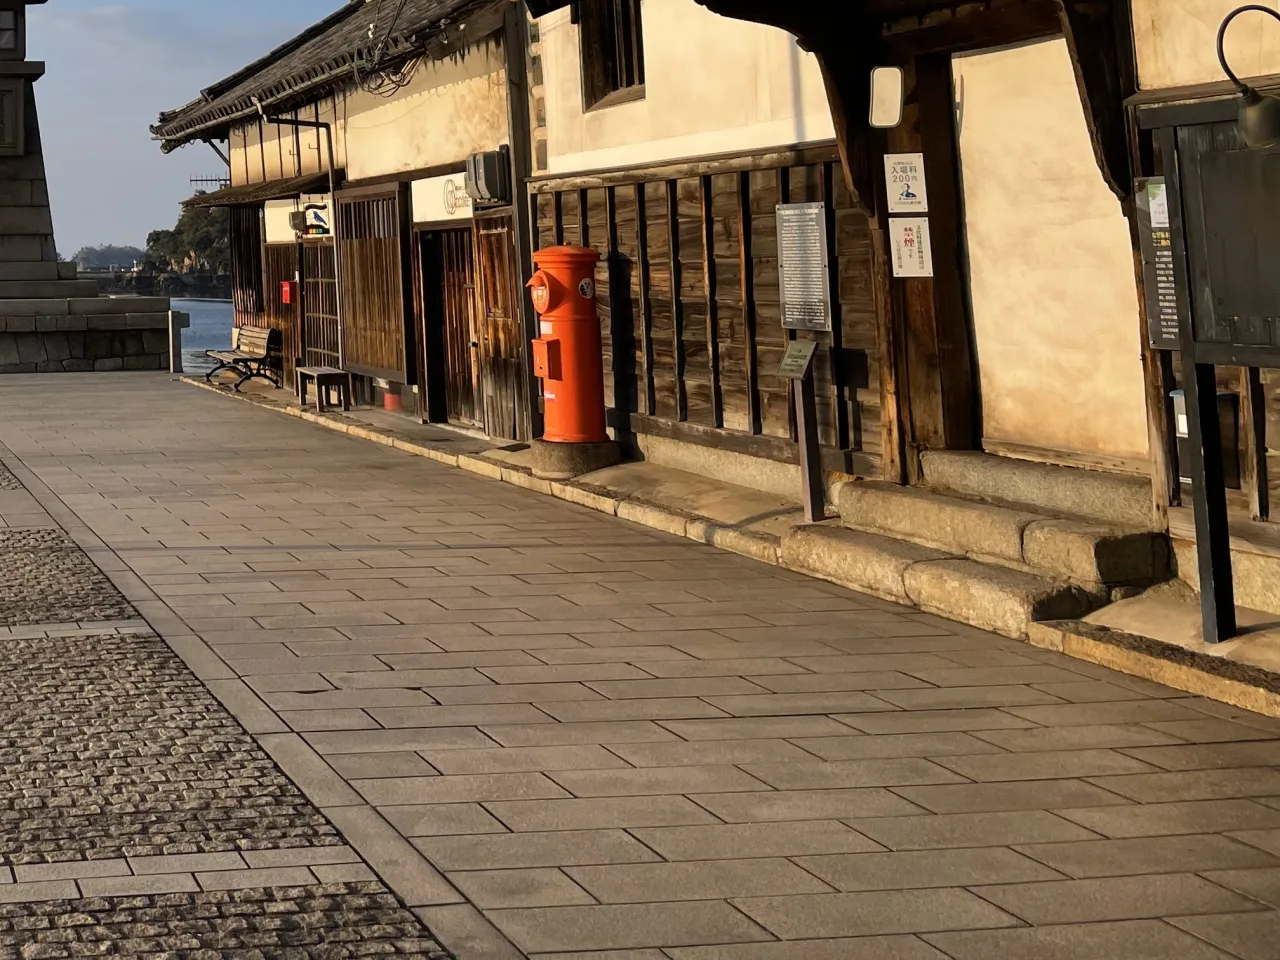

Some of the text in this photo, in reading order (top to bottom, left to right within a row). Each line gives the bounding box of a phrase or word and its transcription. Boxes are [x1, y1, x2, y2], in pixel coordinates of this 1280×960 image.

[891, 166, 917, 174] 入場料
[892, 174, 918, 183] 200円
